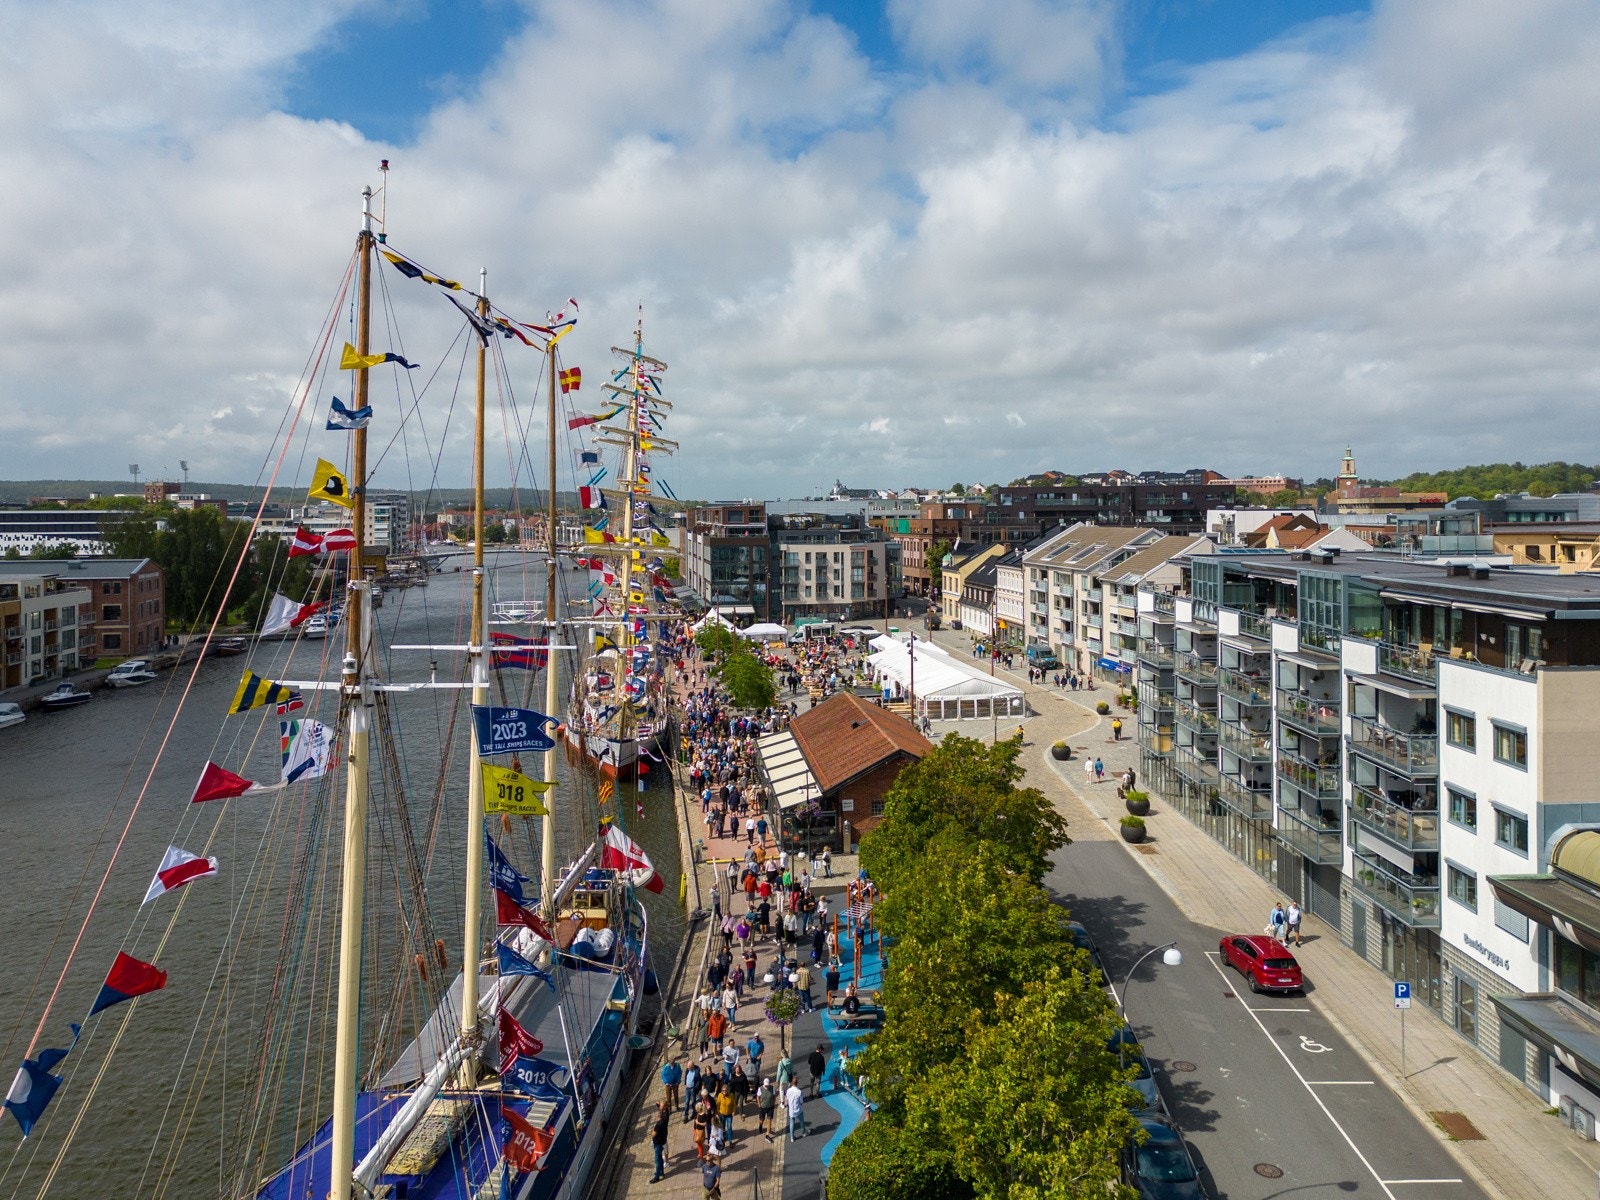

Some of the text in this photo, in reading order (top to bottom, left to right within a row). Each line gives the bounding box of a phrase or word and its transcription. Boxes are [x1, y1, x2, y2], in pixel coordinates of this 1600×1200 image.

[492, 722, 527, 741] 2023
[523, 740, 543, 748] RACES
[1504, 959, 1510, 971] 6
[1398, 984, 1407, 997] P
[517, 1068, 546, 1085] 2013
